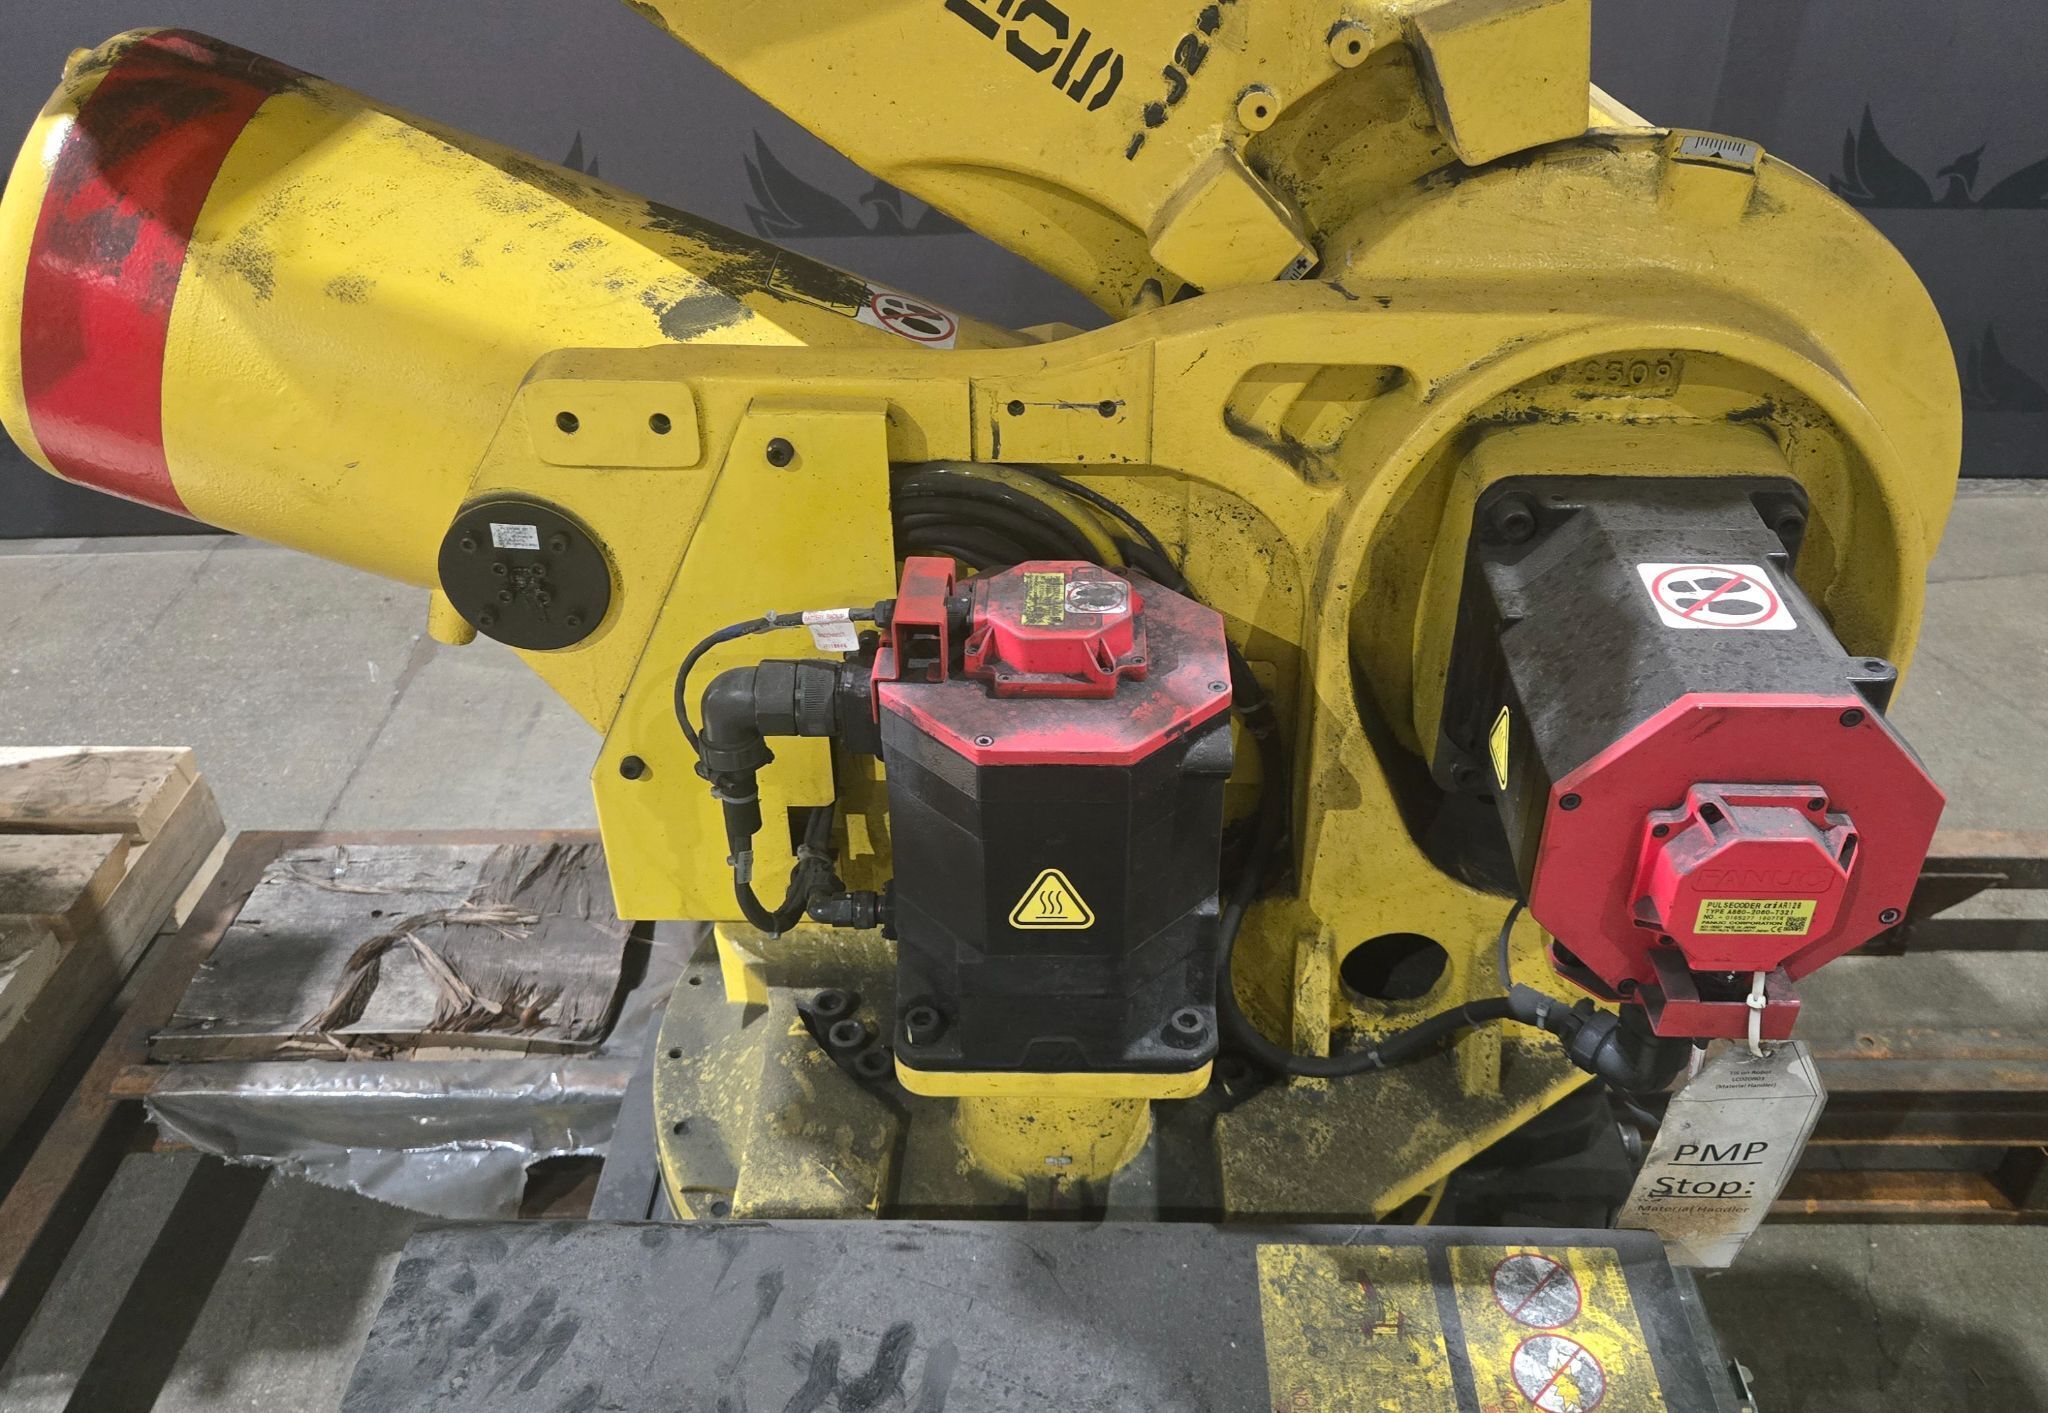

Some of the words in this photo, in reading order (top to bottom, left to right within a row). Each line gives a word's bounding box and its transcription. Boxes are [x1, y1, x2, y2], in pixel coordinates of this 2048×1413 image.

[1162, 33, 1210, 105] J2
[1697, 869, 1827, 888] FANUC
[1707, 901, 1761, 909] PULSECODER
[1673, 1141, 1769, 1162] PMP
[1651, 1176, 1756, 1198] Stop:
